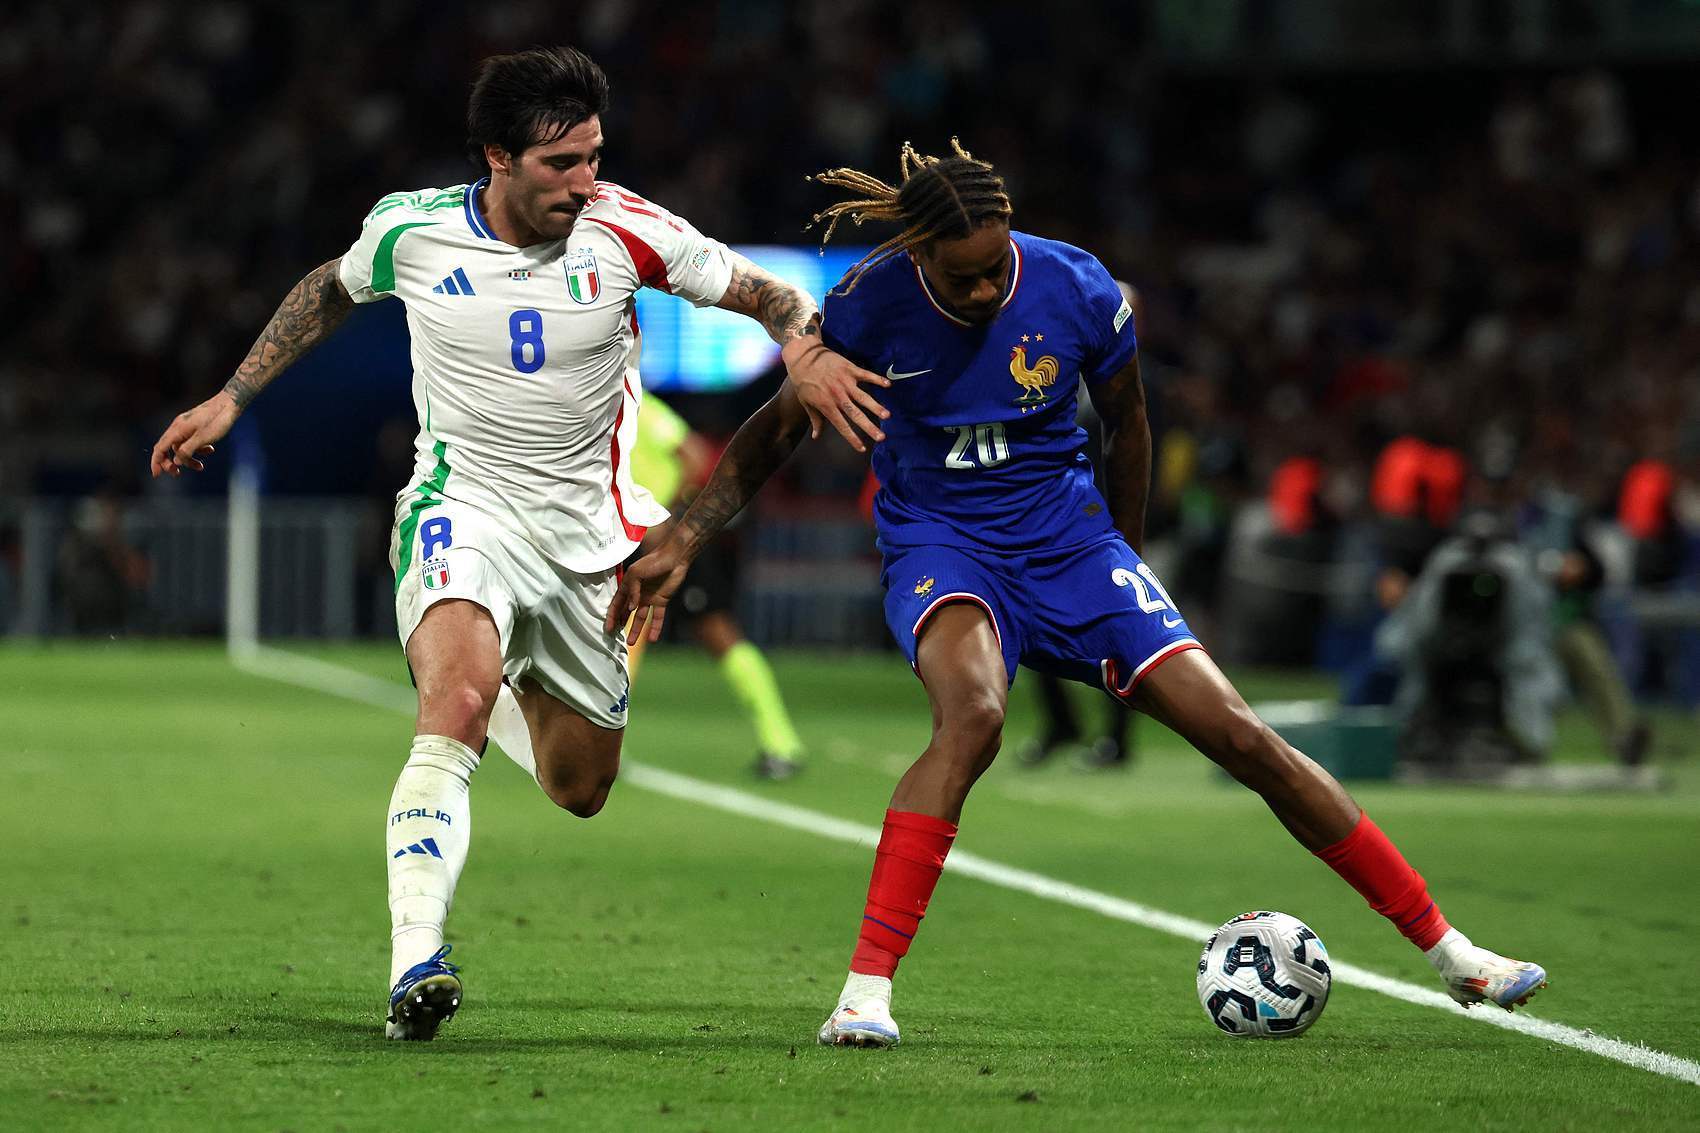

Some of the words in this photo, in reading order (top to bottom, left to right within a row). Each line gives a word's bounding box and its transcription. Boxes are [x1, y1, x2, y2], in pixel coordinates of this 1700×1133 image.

[508, 309, 546, 374] 8
[943, 422, 1010, 469] 20
[420, 516, 453, 561] 8
[424, 563, 446, 575] ITALIA
[391, 808, 451, 827] ITALIA
